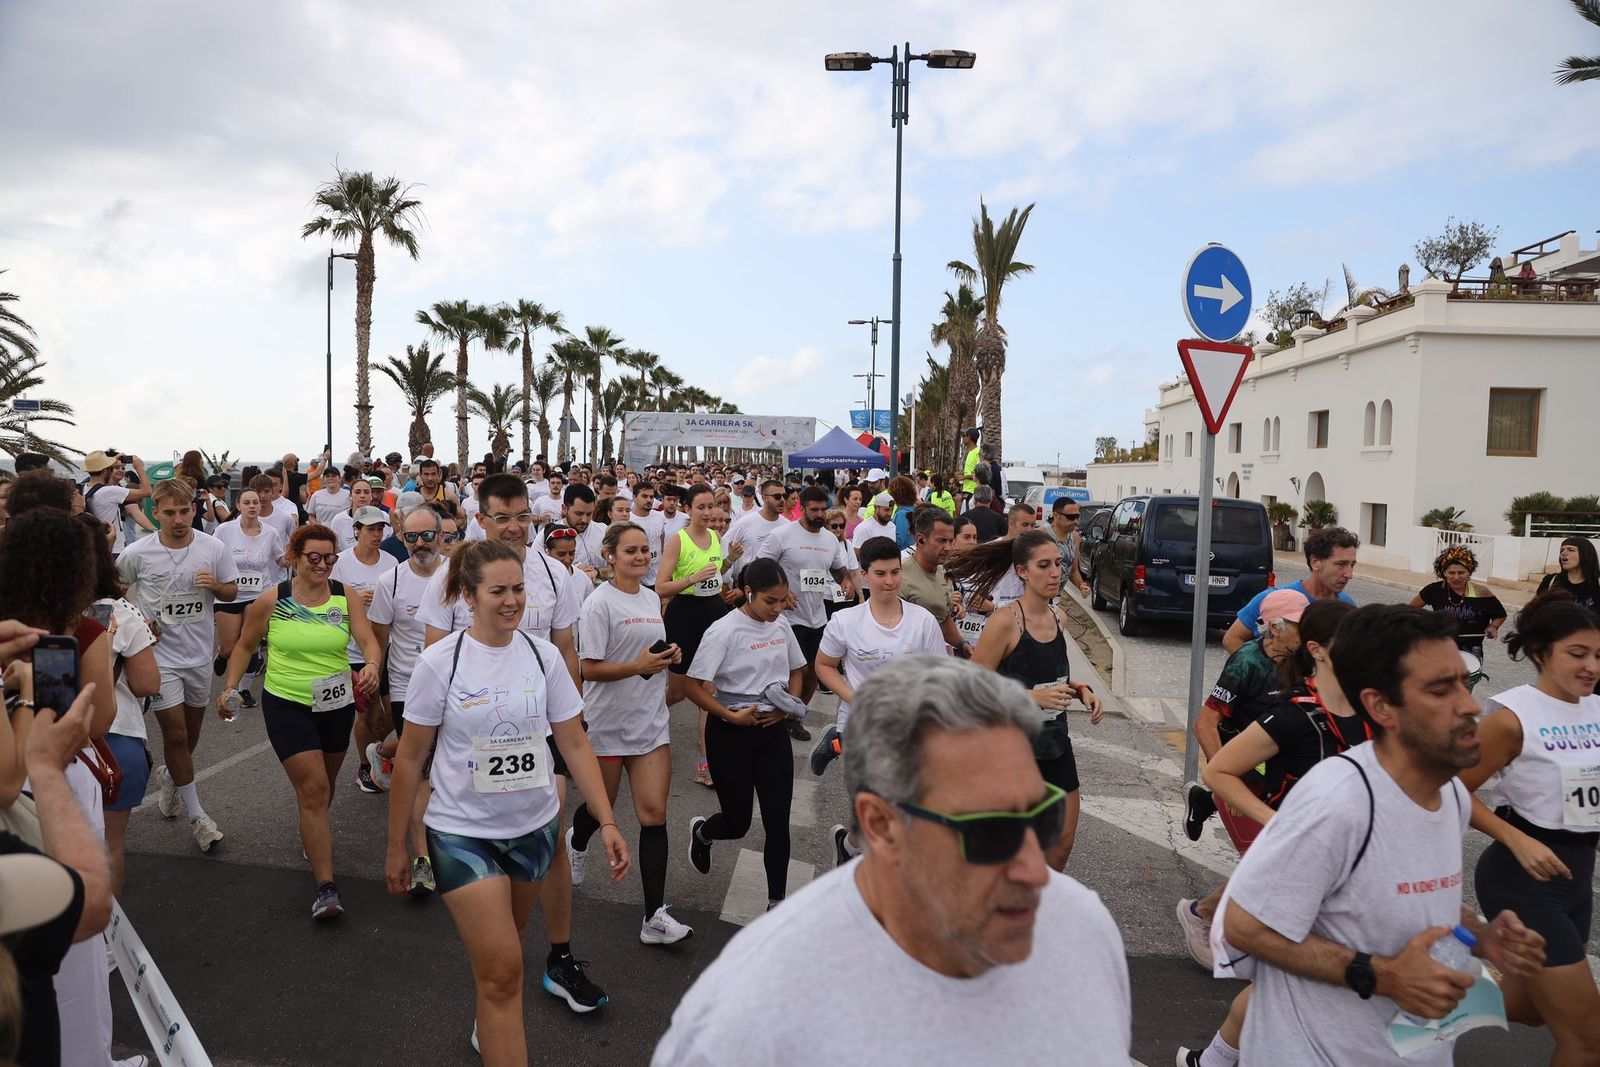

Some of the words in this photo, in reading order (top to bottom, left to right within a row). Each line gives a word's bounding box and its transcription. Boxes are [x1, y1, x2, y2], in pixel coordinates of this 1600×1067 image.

[685, 418, 697, 426] 3A
[698, 419, 740, 427] CARRERA
[742, 420, 754, 428] 5K
[806, 457, 867, 465] info@dorsalchip.es
[236, 576, 260, 585] 1017
[700, 579, 719, 589] 283
[803, 577, 825, 585] 1034
[1211, 577, 1226, 585] HNR
[165, 601, 203, 615] 1279
[958, 620, 980, 632] 1082
[322, 683, 346, 702] 265
[488, 752, 536, 776] 238
[1571, 786, 1600, 808] 10
[1397, 882, 1410, 895] NO
[1440, 877, 1449, 888] NO
